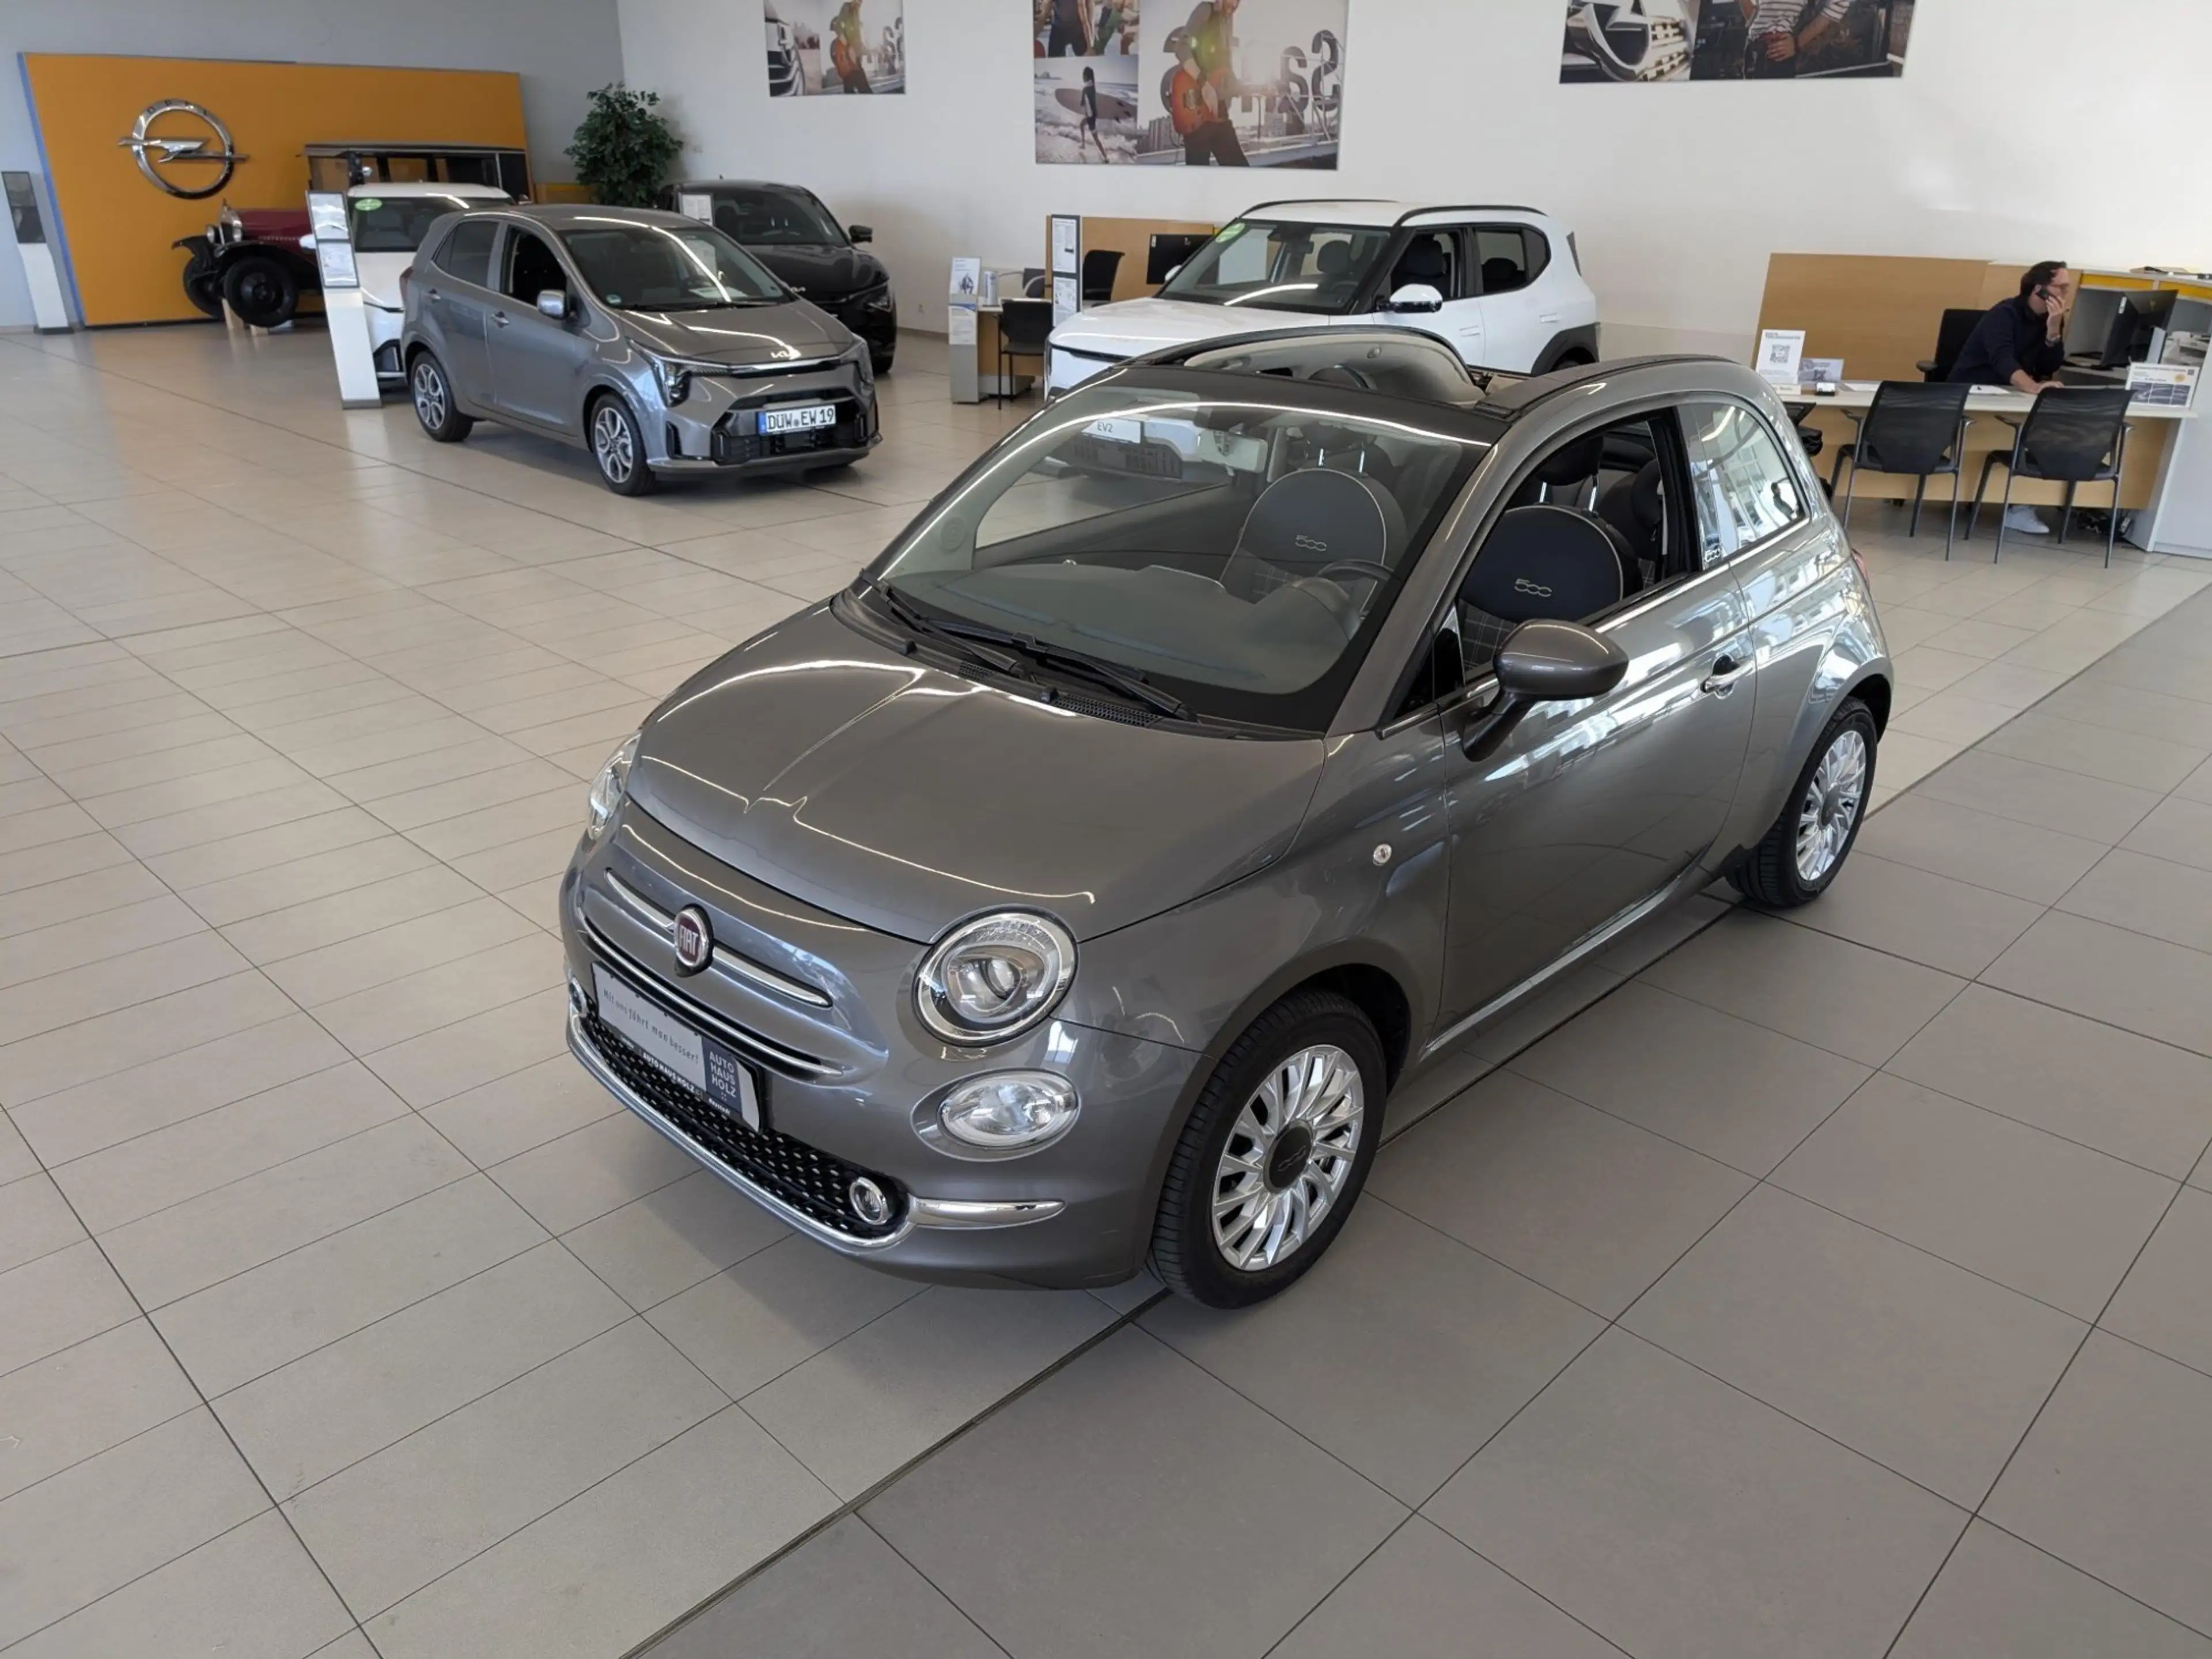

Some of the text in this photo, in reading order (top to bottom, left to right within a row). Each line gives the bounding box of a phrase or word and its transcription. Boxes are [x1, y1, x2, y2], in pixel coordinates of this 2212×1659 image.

[768, 408, 834, 430] DÜW EW 19
[1097, 421, 1113, 433] EV2
[1295, 535, 1327, 551] 500
[1514, 578, 1552, 597] 500
[680, 924, 699, 956] FIAT
[604, 988, 614, 1003] Mit
[709, 1051, 735, 1074] AUTO
[710, 1062, 736, 1085] HAUS
[711, 1075, 737, 1098] HOLZ
